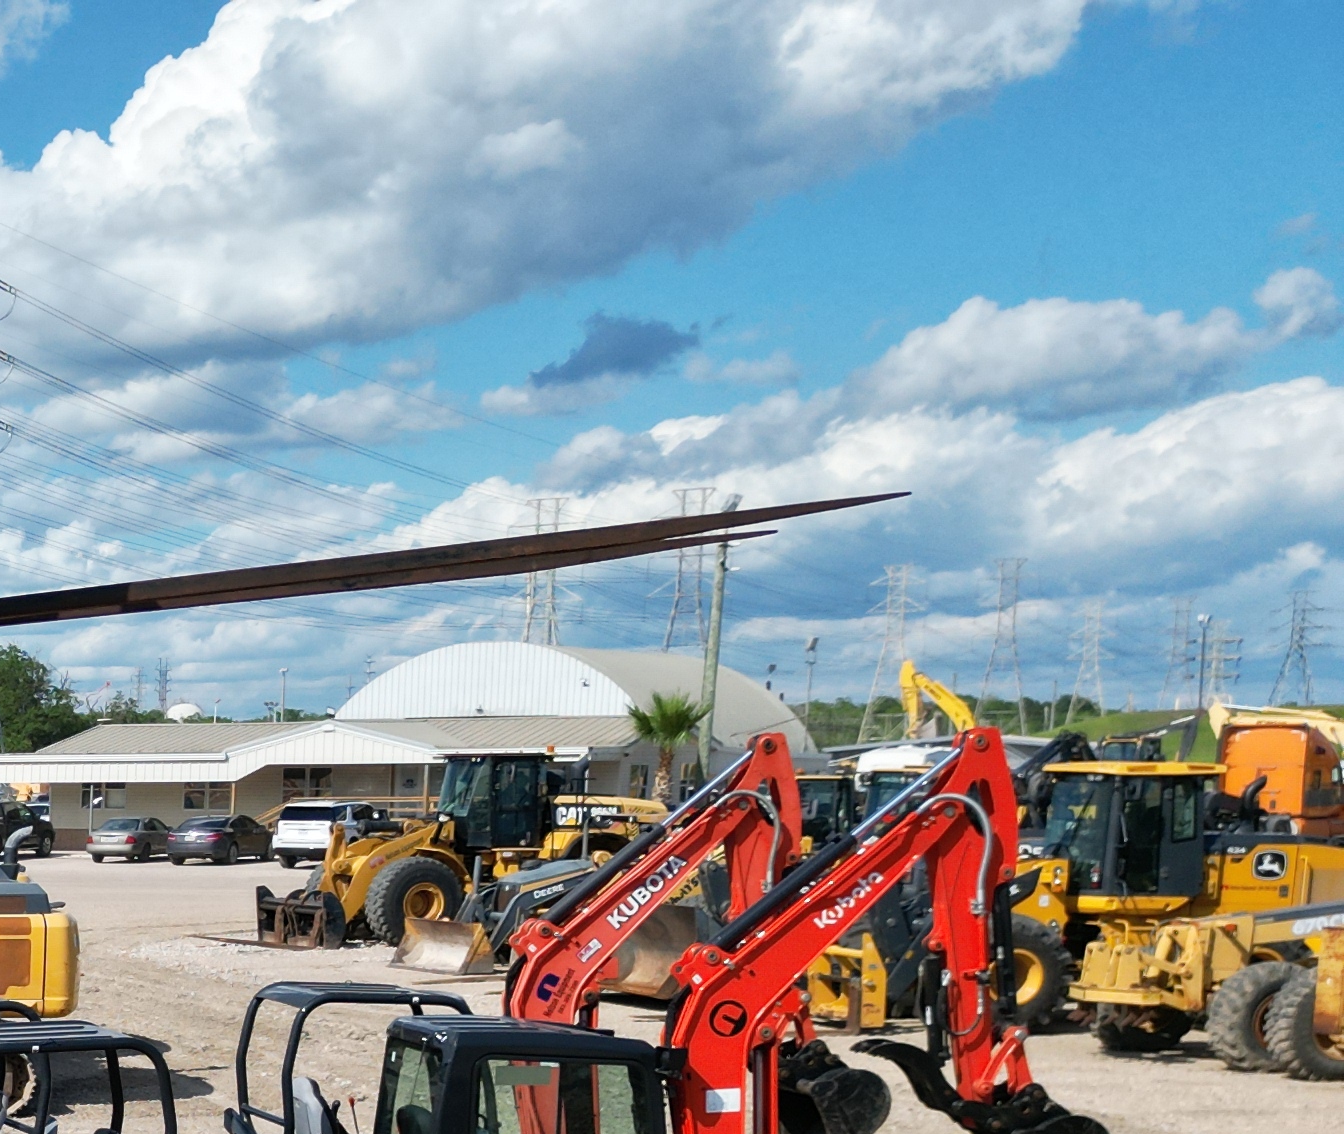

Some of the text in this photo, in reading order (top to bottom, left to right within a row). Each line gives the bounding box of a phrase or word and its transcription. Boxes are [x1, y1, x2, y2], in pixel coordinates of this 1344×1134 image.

[556, 806, 583, 826] CAT
[533, 883, 564, 899] DEERE
[605, 855, 688, 930] KUBOTA
[813, 872, 884, 928] Kubota
